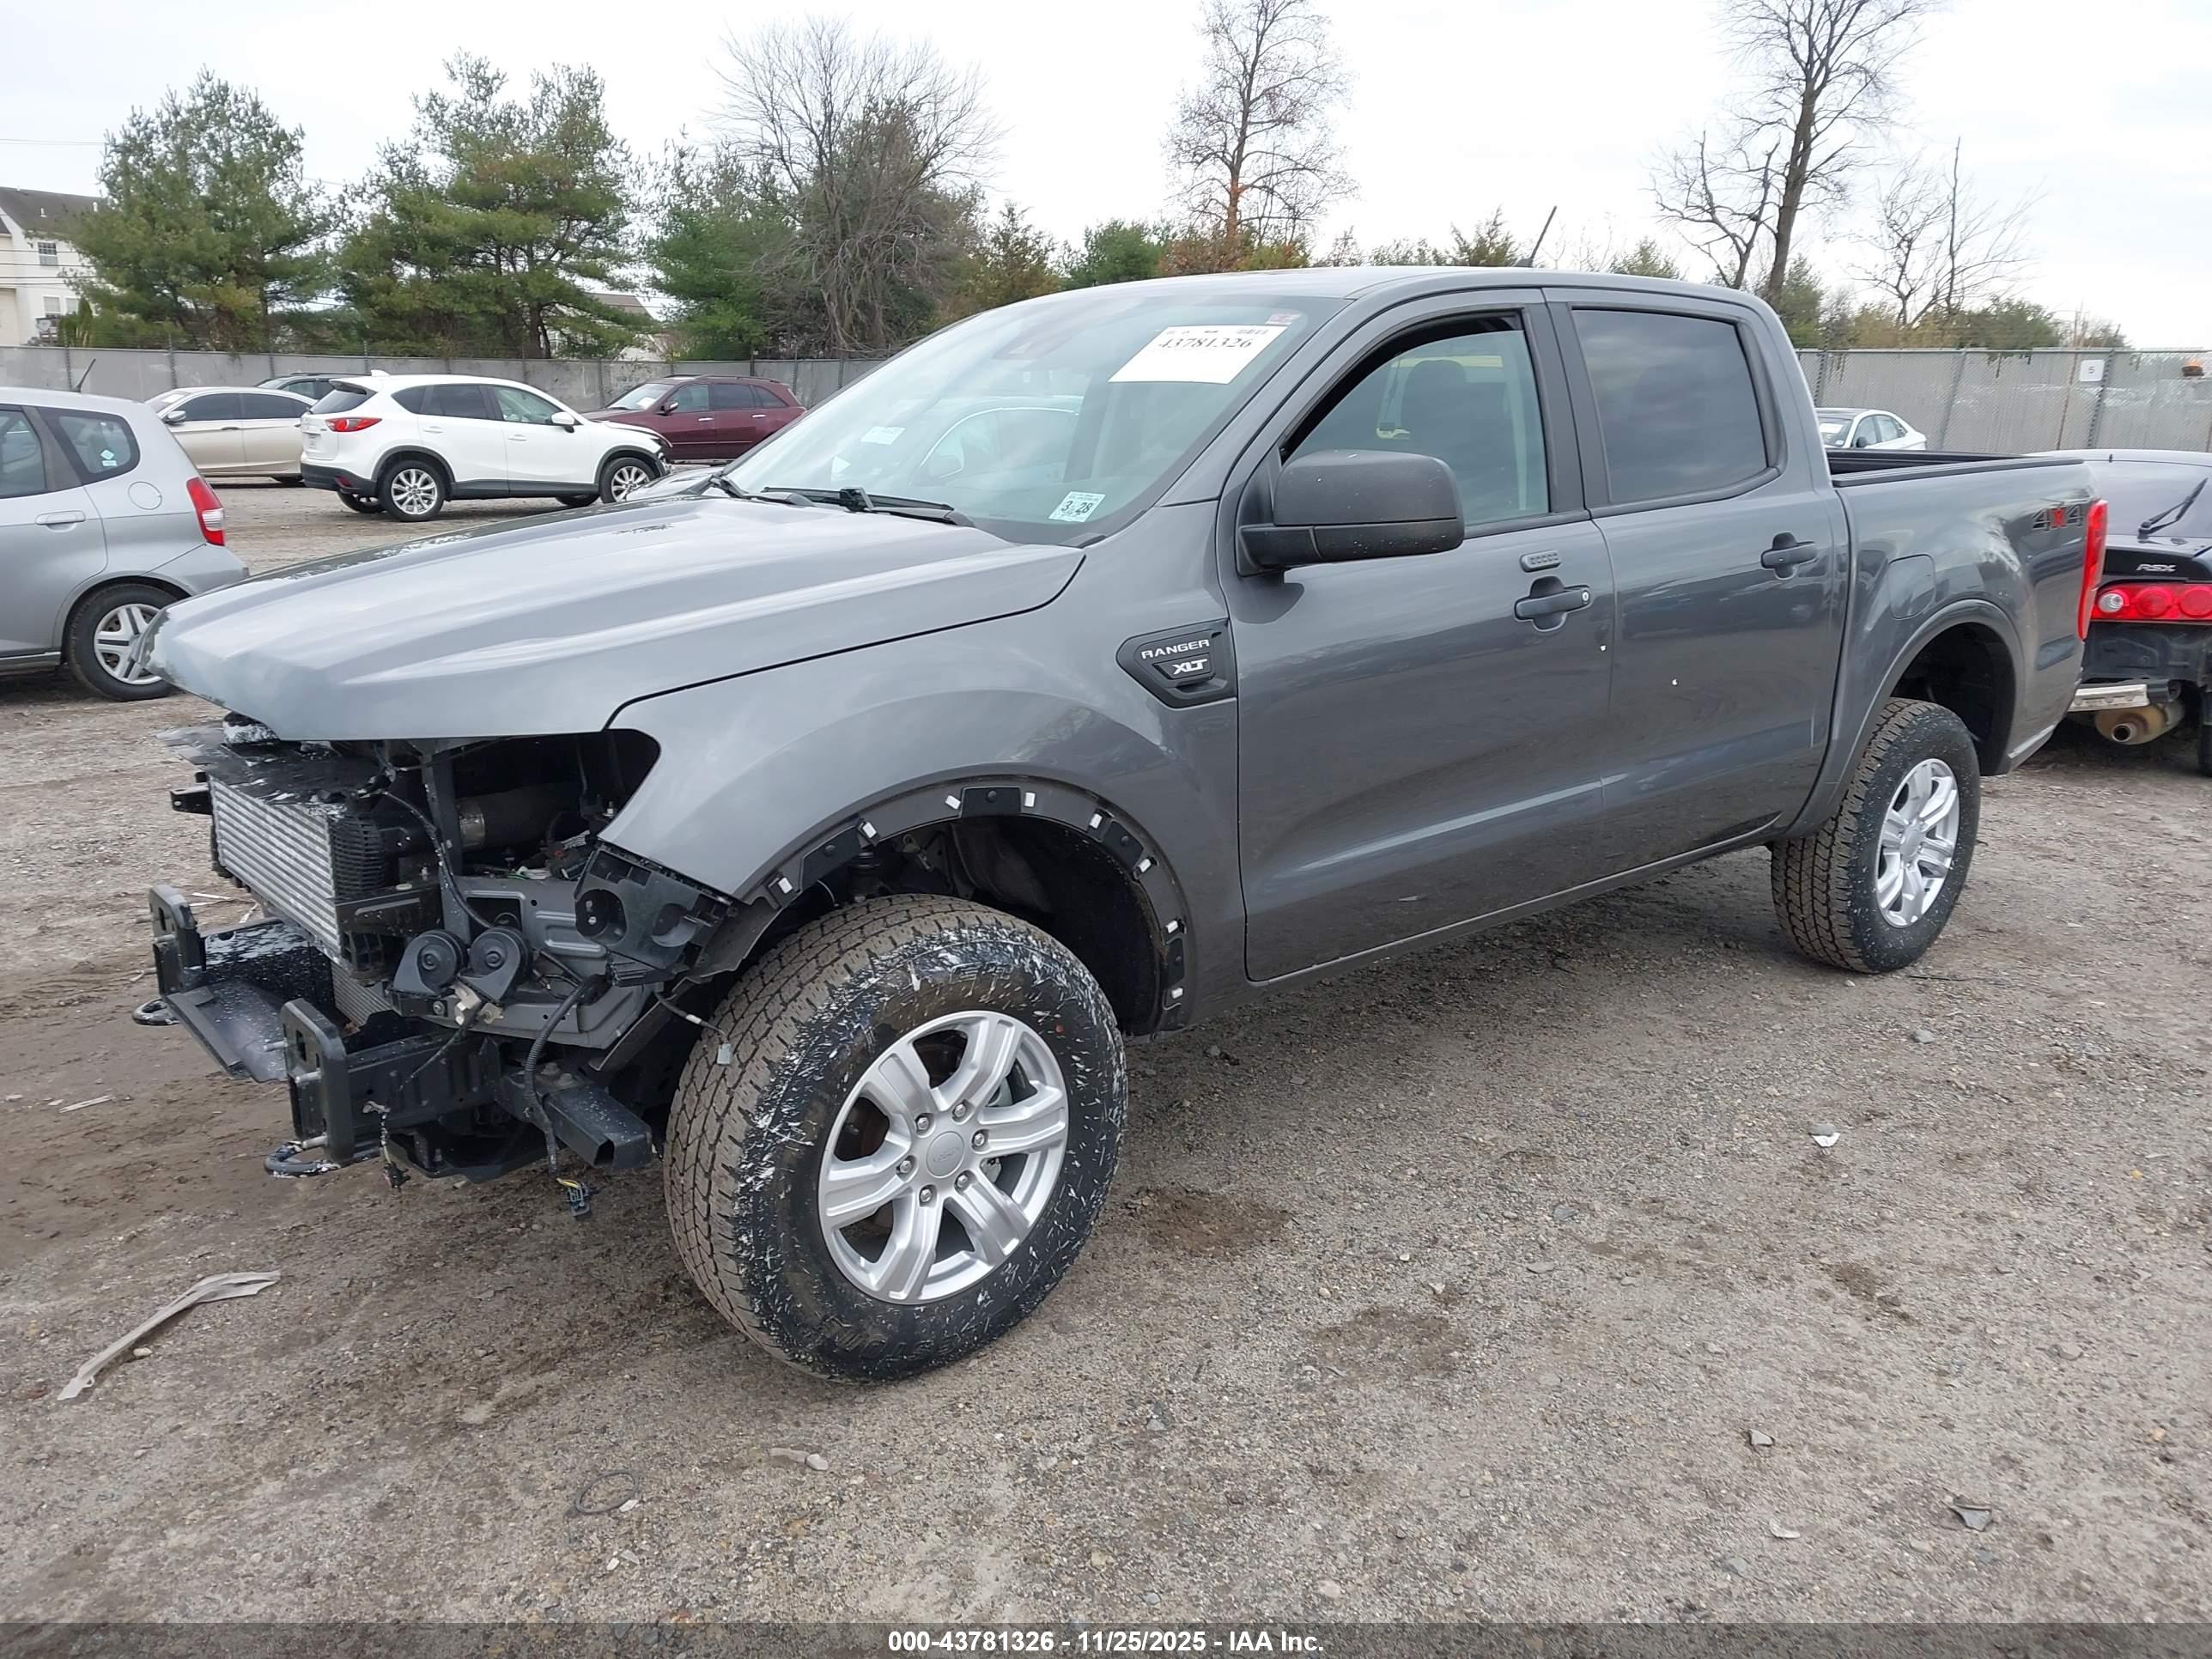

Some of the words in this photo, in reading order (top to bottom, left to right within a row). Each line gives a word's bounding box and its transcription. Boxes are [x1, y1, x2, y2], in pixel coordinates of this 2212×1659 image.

[1158, 337, 1253, 349] 43781326
[1060, 500, 1073, 512] 3
[1074, 501, 1093, 514] 28
[2136, 563, 2177, 573] RSX
[1140, 639, 1211, 659] RANGER
[1171, 658, 1208, 675] XLT
